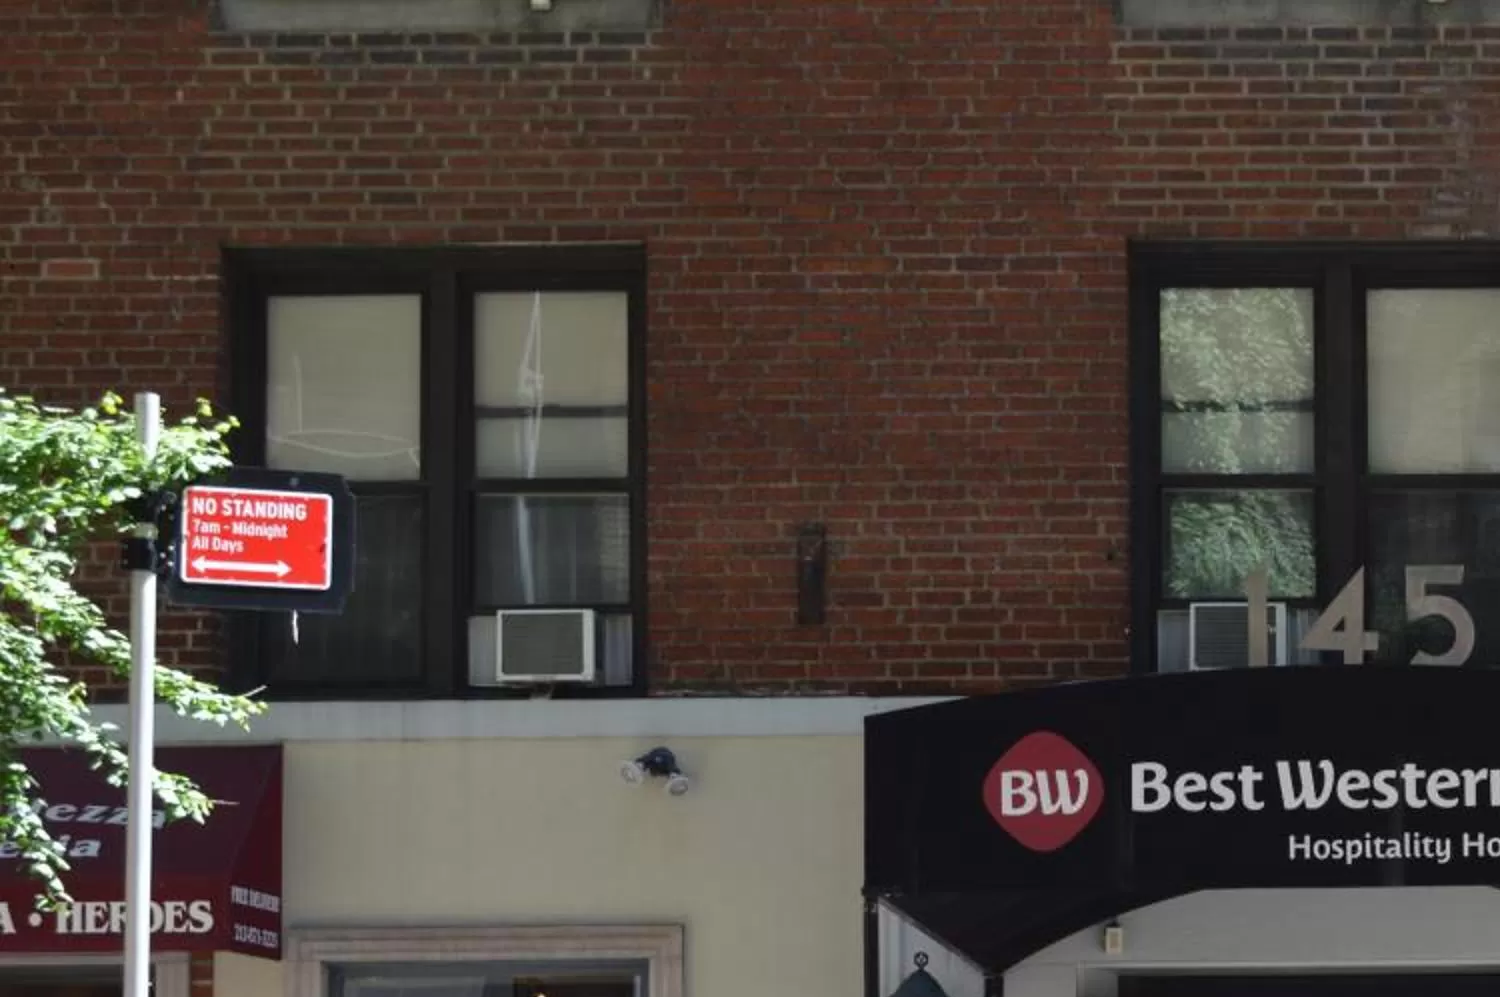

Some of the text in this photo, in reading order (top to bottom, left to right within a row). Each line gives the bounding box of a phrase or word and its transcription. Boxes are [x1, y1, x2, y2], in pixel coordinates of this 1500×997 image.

[192, 496, 307, 521] NO STANDING
[192, 519, 221, 533] 7am
[232, 521, 288, 540] Midnight
[192, 535, 244, 554] All Days
[1246, 563, 1476, 667] 145
[1000, 768, 1090, 817] BW
[1130, 761, 1265, 813] Best
[1288, 831, 1452, 865] Hospitality
